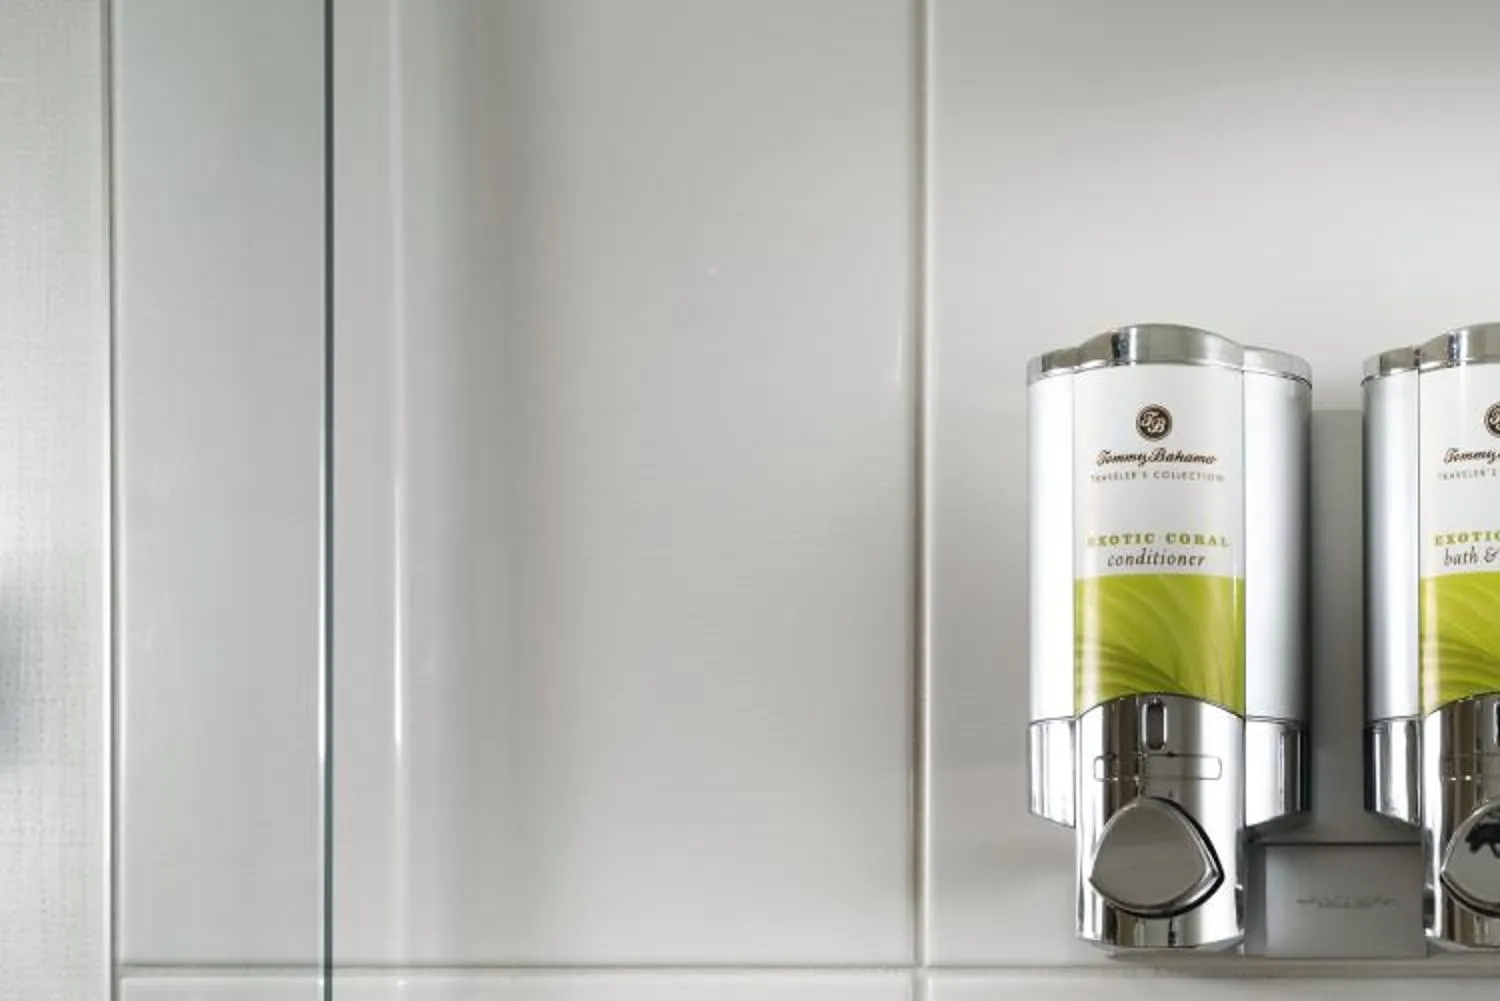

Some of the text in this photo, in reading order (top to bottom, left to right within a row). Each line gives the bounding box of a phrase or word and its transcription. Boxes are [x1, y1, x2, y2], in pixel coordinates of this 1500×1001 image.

[1096, 448, 1216, 467] Tommy Bahama
[1443, 448, 1499, 464] Tommy
[1165, 533, 1230, 547] CORAL
[1107, 548, 1206, 567] conditioner
[1443, 546, 1479, 566] bath
[1483, 547, 1498, 564] &
